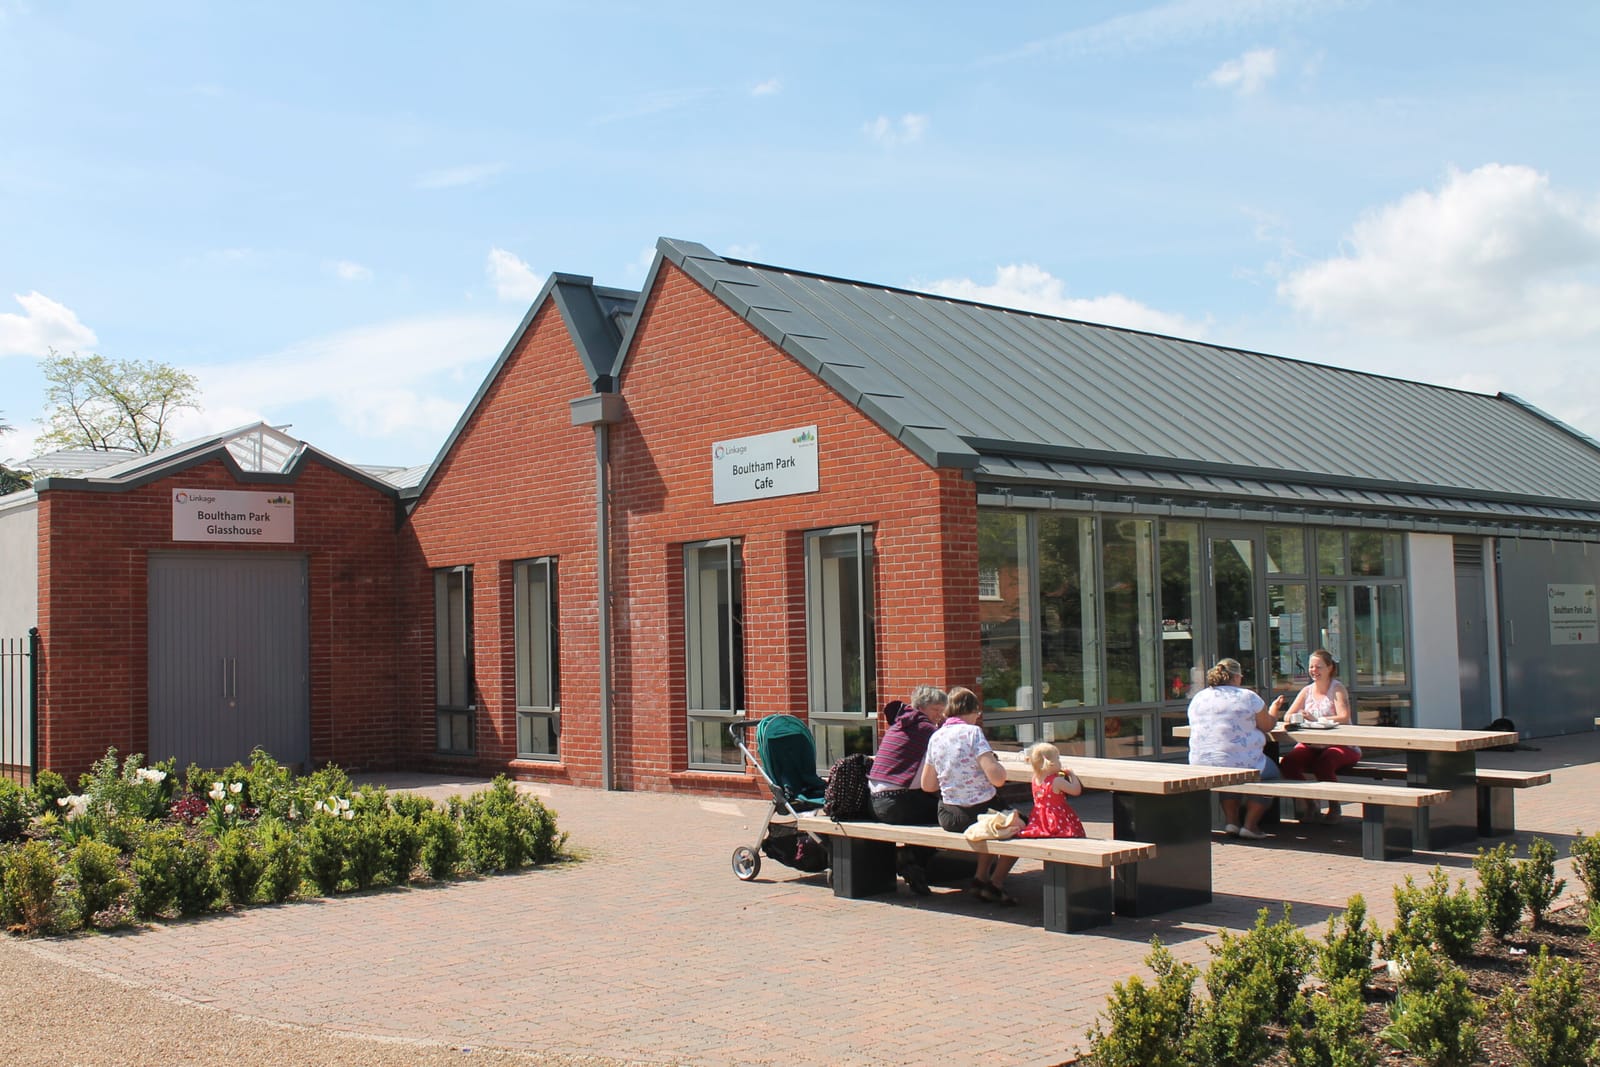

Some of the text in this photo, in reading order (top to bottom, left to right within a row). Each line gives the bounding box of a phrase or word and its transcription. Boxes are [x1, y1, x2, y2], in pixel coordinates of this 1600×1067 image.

[725, 445, 747, 455] Linkage
[732, 456, 796, 476] Boultham Park
[754, 477, 774, 490] Cafe
[189, 494, 216, 504] Linkage
[197, 510, 271, 522] Boultham Park
[206, 525, 263, 536] Glasshouse
